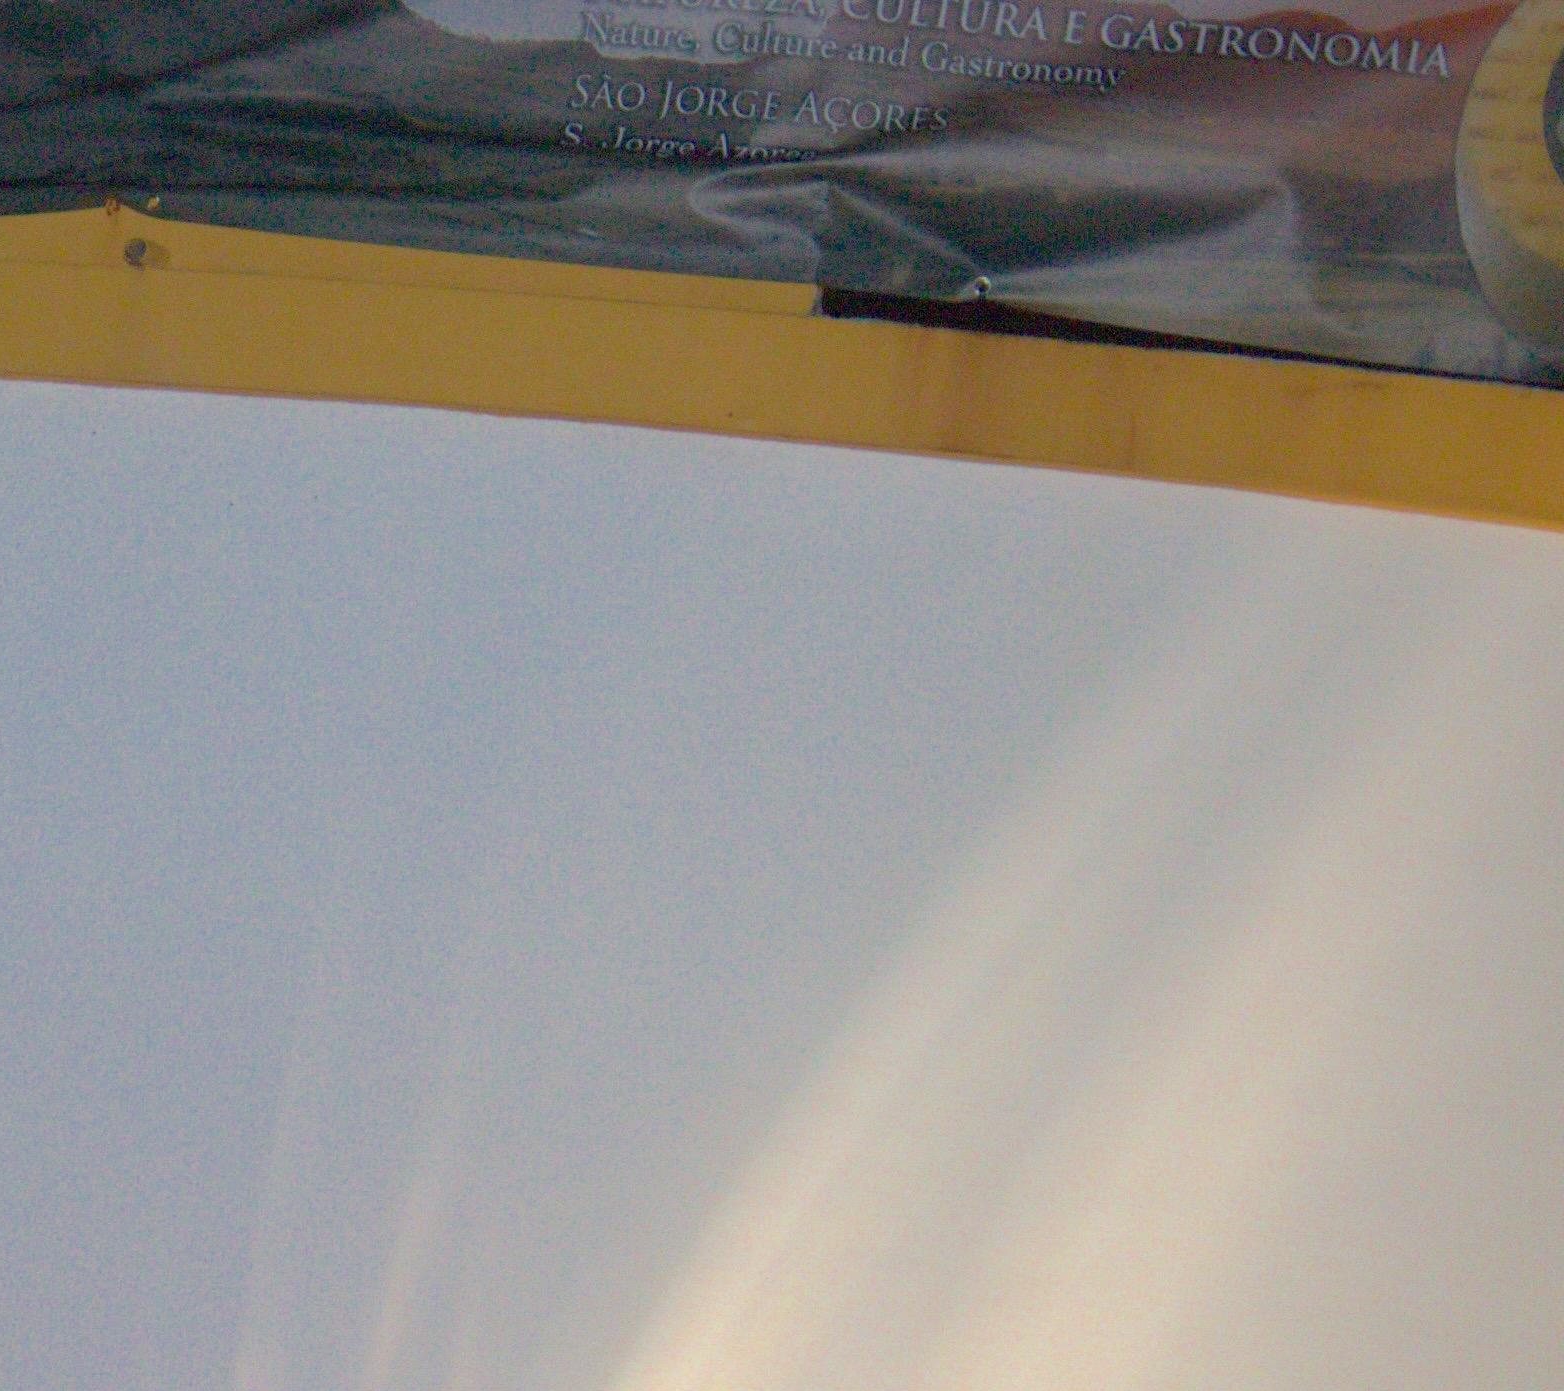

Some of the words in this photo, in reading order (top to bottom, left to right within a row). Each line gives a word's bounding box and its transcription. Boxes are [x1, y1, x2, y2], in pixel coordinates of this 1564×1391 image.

[580, 11, 702, 52] Nature,
[713, 17, 839, 61] Culture
[847, 36, 911, 68] and
[919, 40, 1127, 95] Gastronomy
[1062, 10, 1088, 46] E
[1100, 12, 1453, 79] GASTRONOMIA
[569, 72, 647, 112] SÃO
[657, 79, 782, 122] JORGE
[793, 90, 951, 134] AÇORES
